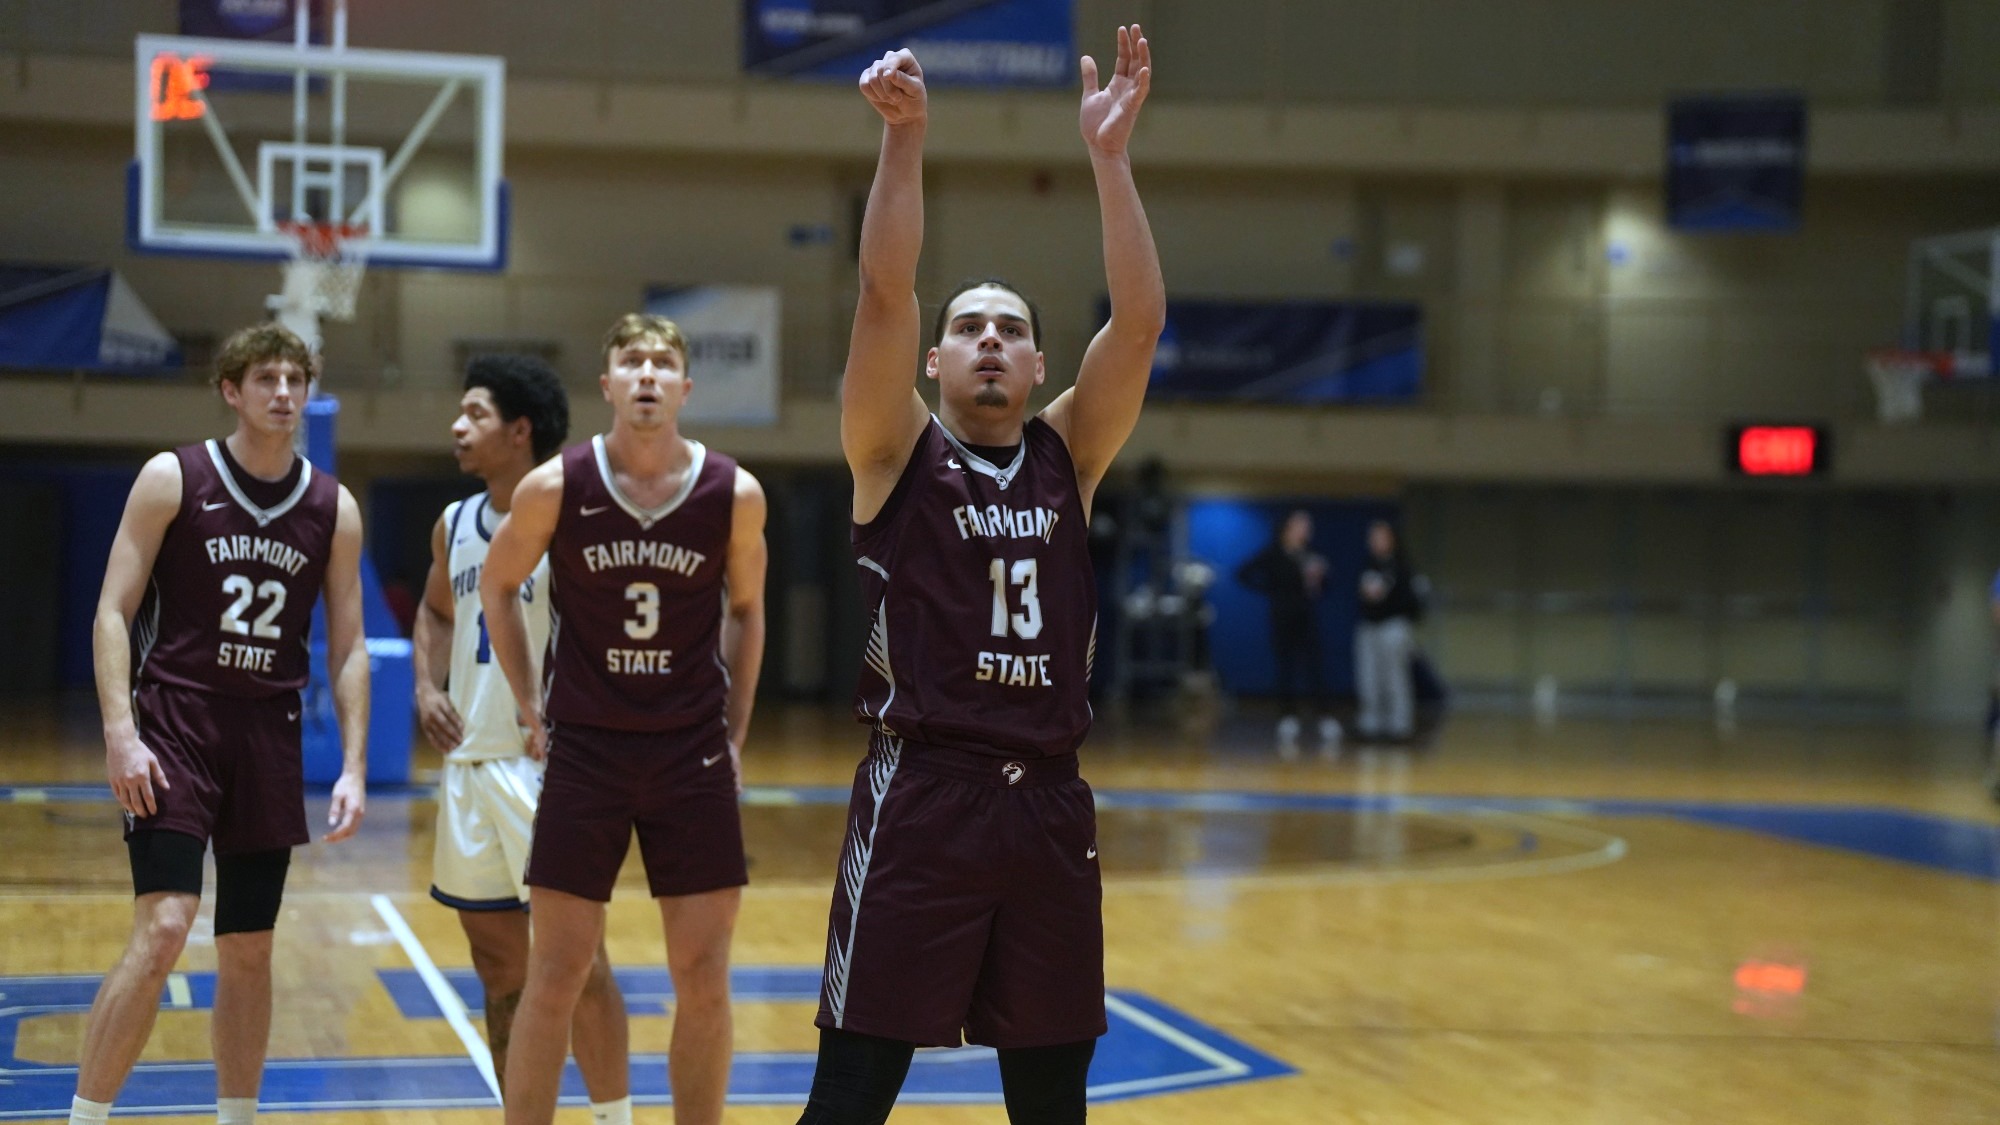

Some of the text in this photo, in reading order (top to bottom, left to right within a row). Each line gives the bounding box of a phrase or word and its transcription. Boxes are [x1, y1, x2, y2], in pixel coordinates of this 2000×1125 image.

[952, 504, 1060, 545] FAIRMONT
[205, 534, 309, 577] FAIRMONT
[583, 540, 706, 577] FAIRMONT
[219, 573, 288, 640] 22
[624, 581, 661, 640] 3
[989, 558, 1044, 640] 13
[217, 641, 277, 673] STATE
[606, 648, 673, 675] STATE
[975, 651, 1053, 687] STATE
